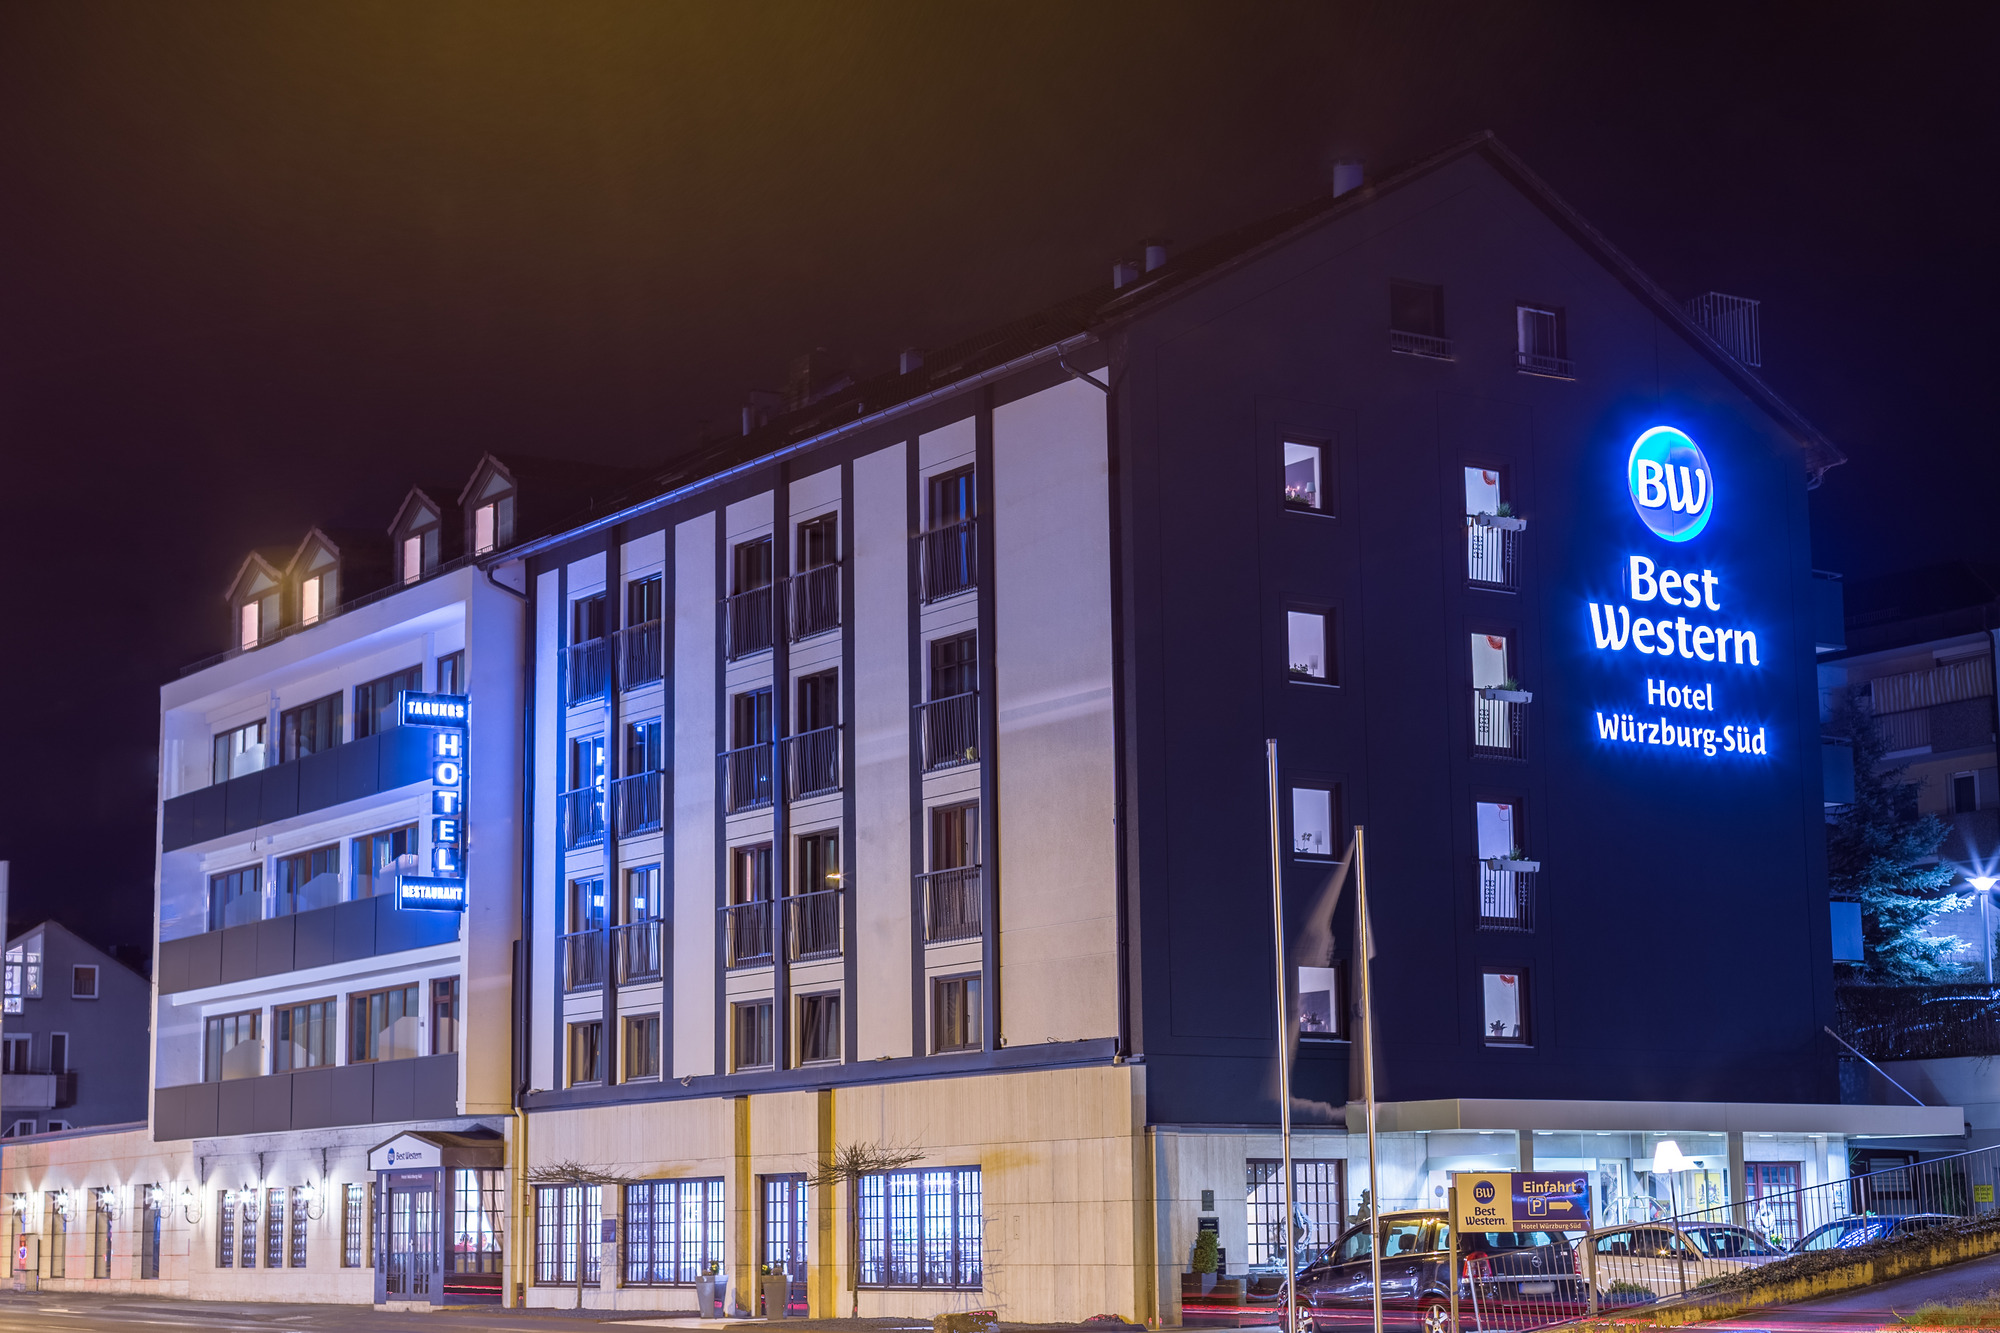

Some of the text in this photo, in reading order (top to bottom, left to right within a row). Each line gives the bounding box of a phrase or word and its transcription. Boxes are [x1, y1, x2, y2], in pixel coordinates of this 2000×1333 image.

[1637, 459, 1706, 515] BW
[1630, 555, 1720, 611] Best
[1589, 602, 1760, 666] Western
[1647, 678, 1714, 712] Hotel
[1596, 711, 1767, 757] Würzburg-Süd
[438, 734, 459, 871] HOTEL
[402, 885, 463, 900] RESTAURANT
[396, 1152, 405, 1160] Best
[1475, 1187, 1494, 1199] BW
[1523, 1180, 1577, 1194] Einfahrt
[1474, 1206, 1496, 1216] Best
[1532, 1199, 1542, 1213] P
[1465, 1216, 1505, 1226] Western
[1539, 1222, 1582, 1231] Würzburg-Süd
